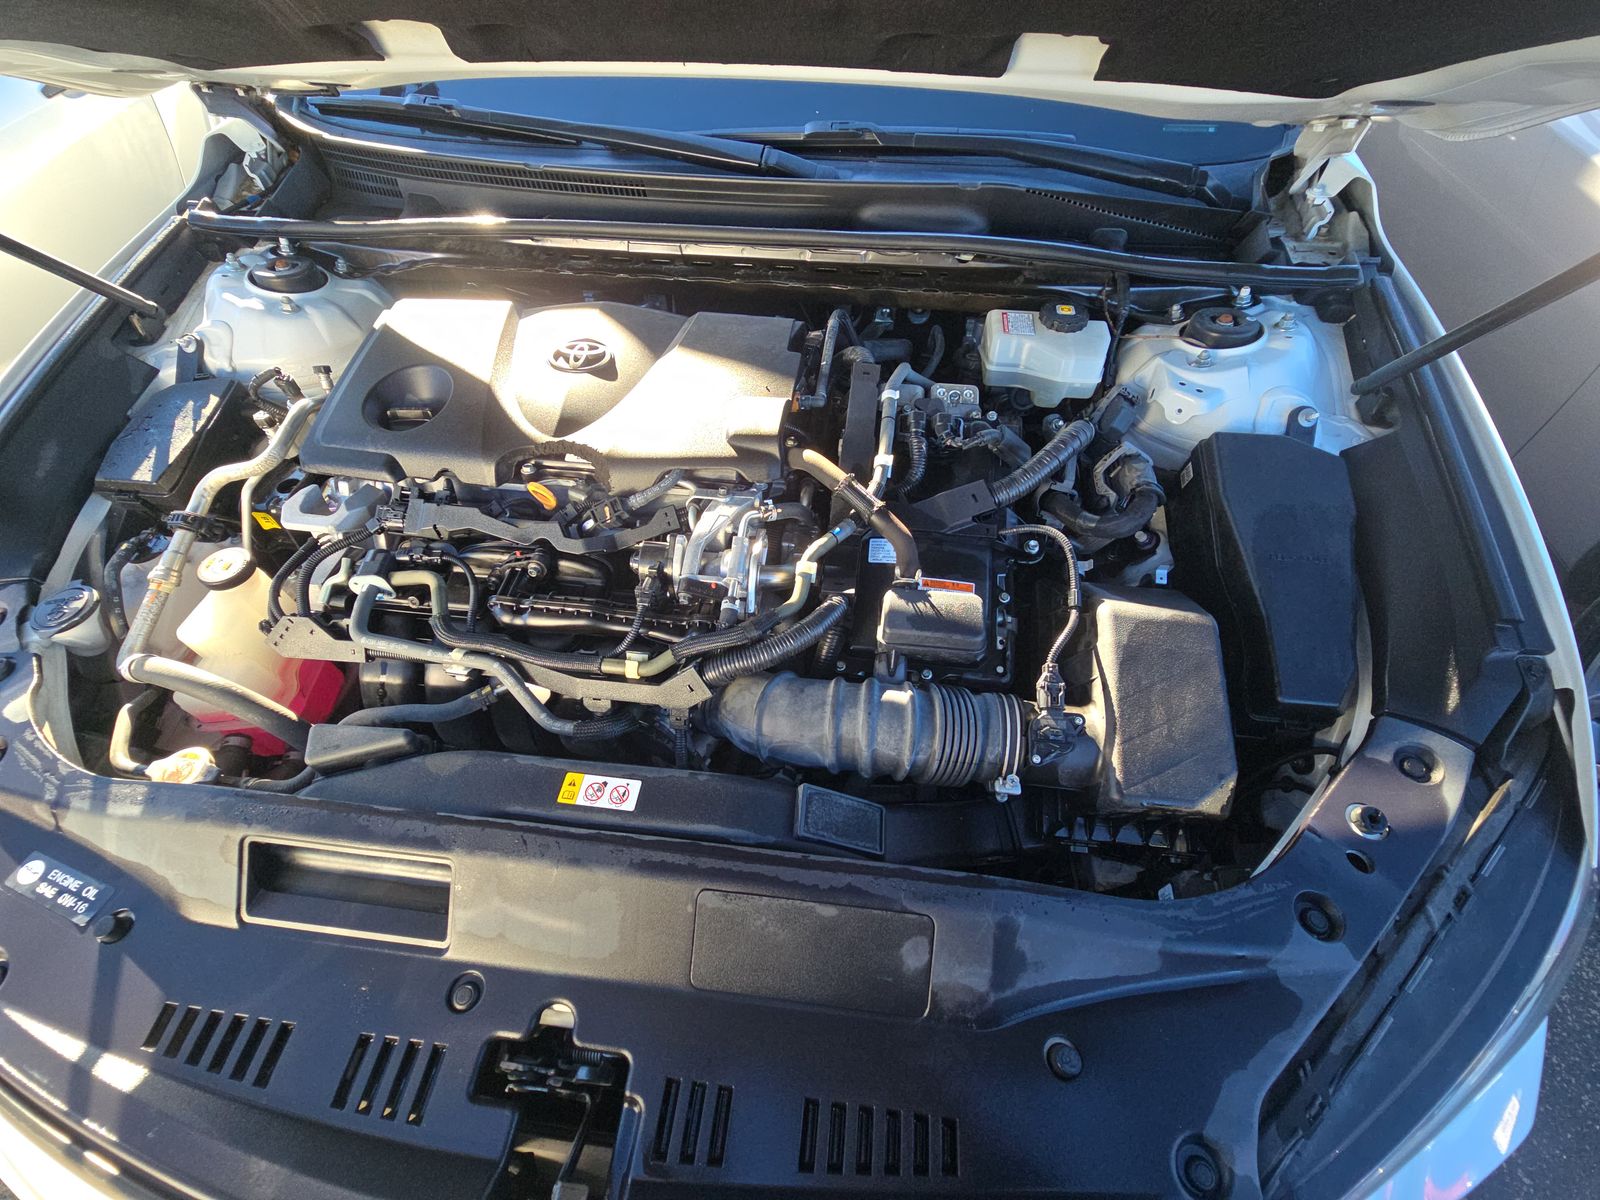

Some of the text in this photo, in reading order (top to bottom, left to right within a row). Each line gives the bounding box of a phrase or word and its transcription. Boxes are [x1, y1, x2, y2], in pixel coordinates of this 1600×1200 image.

[36, 882, 59, 898] SAE
[47, 869, 99, 900] ENGINE OIL
